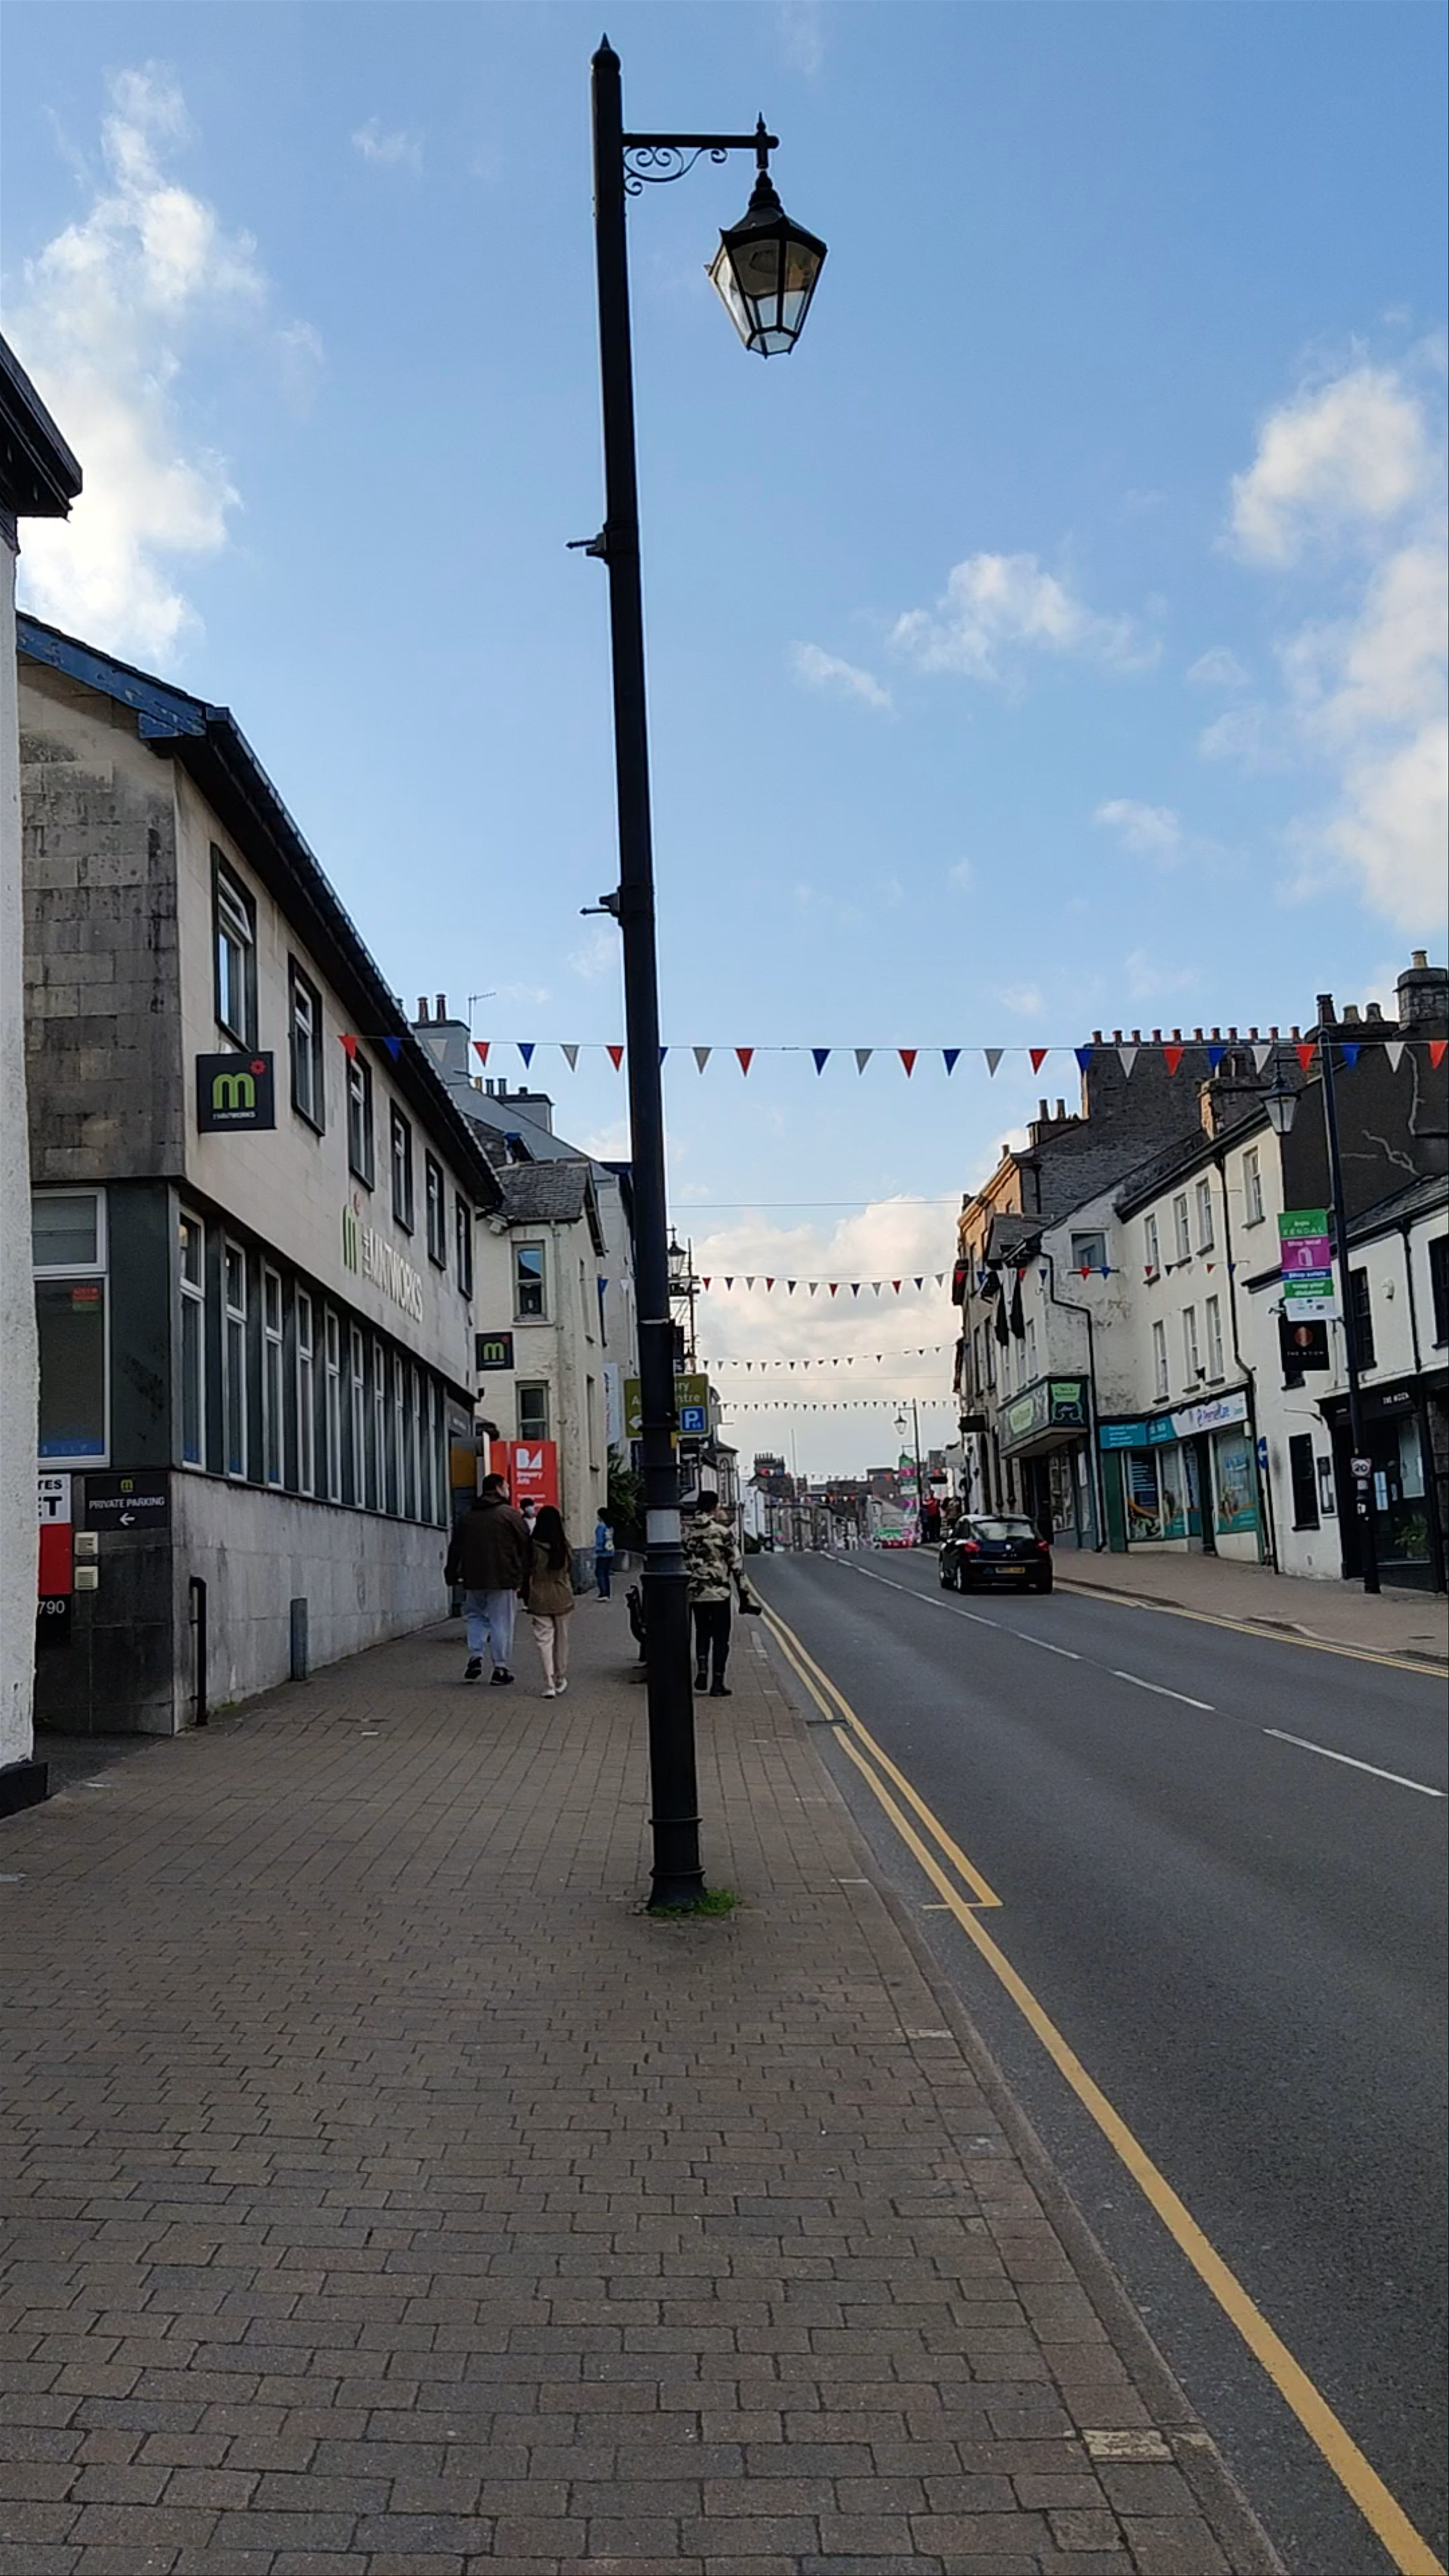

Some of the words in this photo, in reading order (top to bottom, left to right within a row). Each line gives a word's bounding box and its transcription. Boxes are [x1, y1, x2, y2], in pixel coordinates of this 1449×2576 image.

[1283, 1227, 1324, 1236] KENDAL
[675, 1395, 701, 1404] ntre
[685, 1410, 699, 1429] P
[1354, 1463, 1368, 1472] 20
[89, 1498, 125, 1509] PRIVATE
[127, 1496, 165, 1507] PARKING
